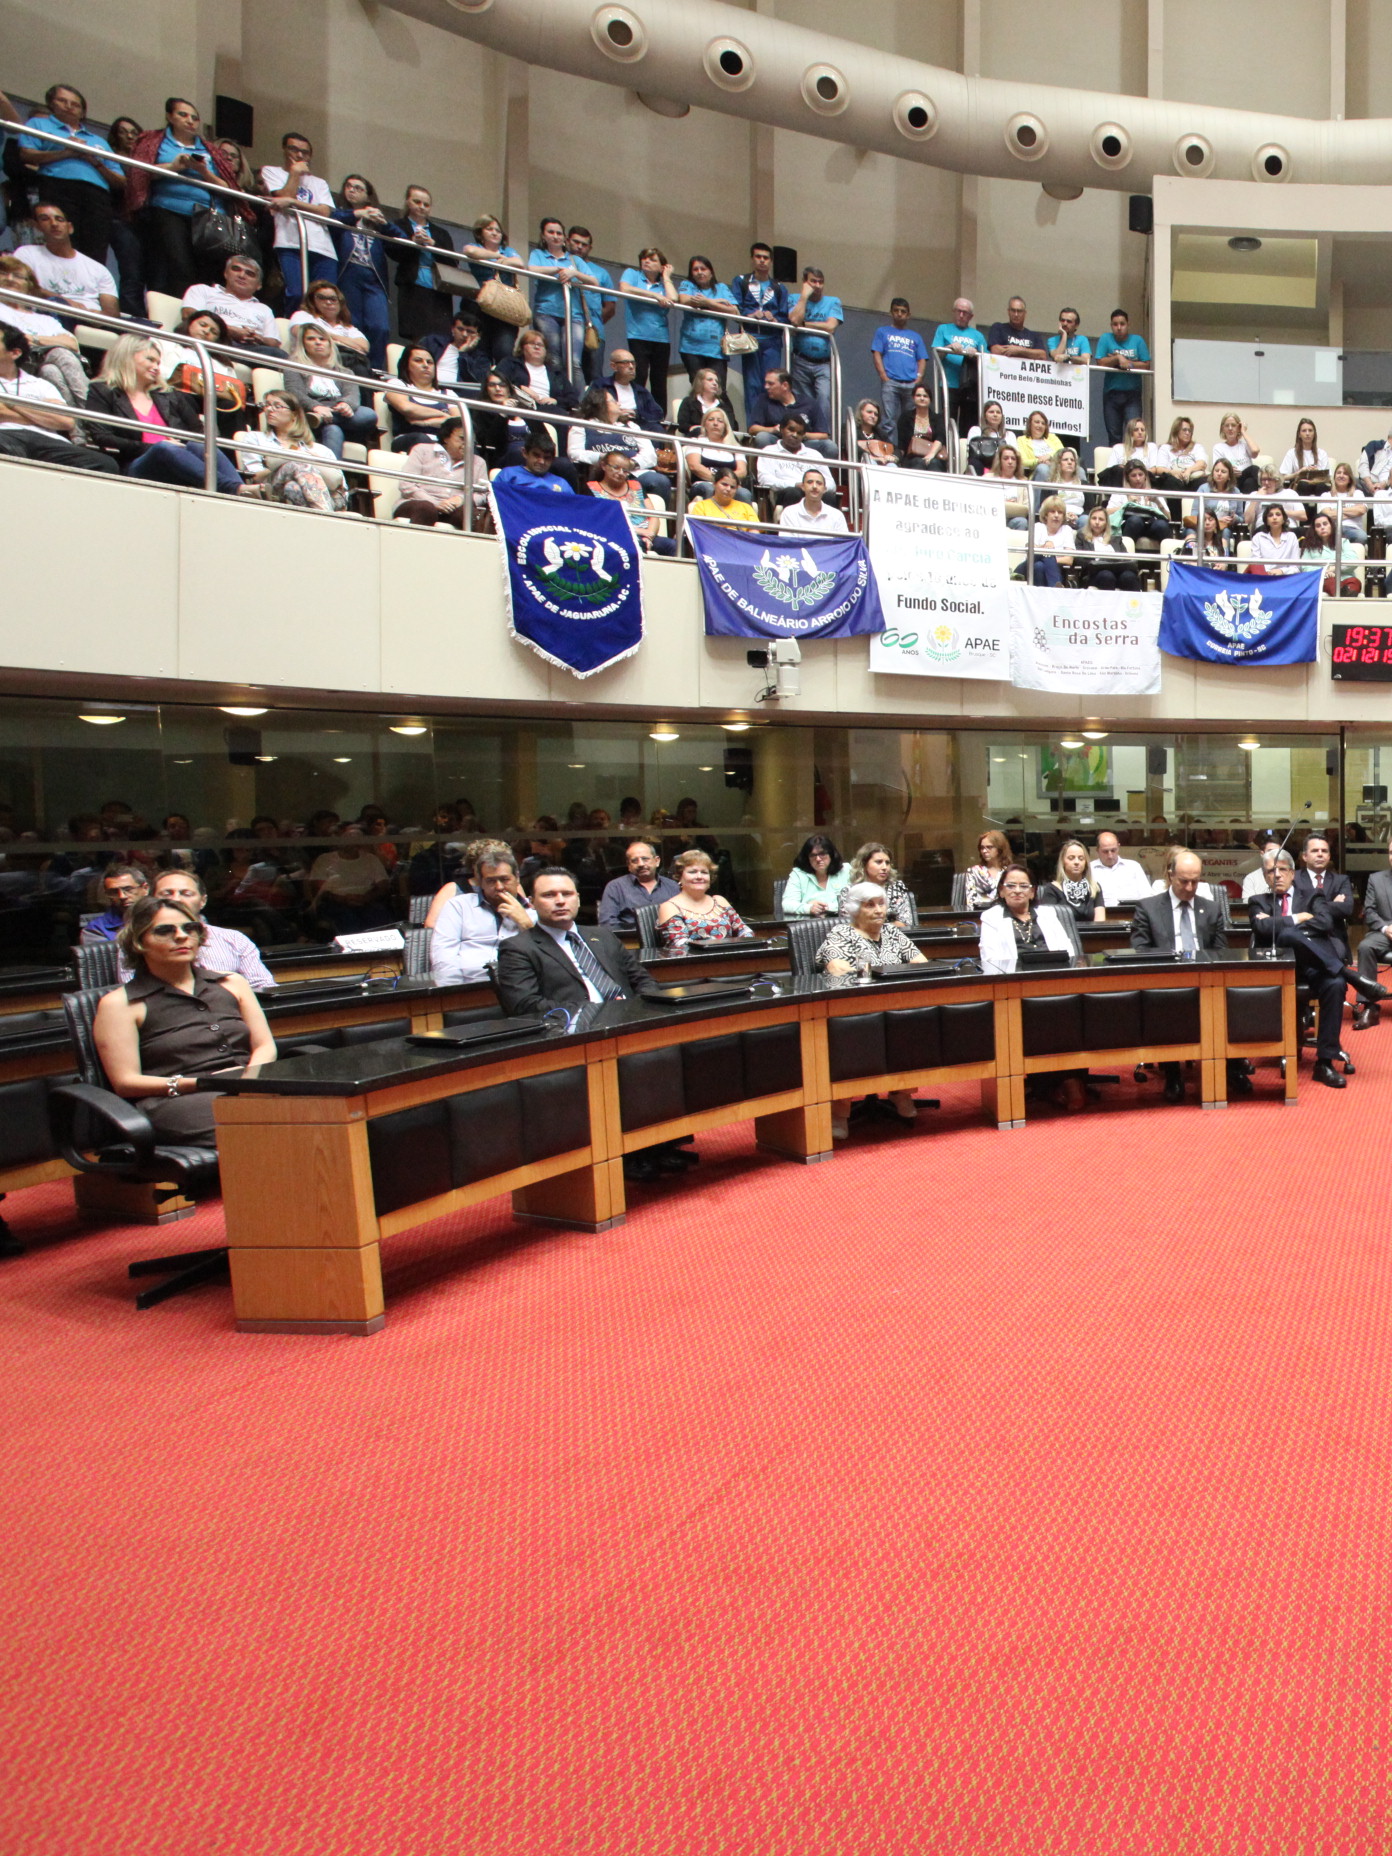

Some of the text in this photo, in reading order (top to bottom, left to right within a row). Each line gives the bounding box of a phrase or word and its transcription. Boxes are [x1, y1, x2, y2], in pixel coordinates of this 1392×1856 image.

[1020, 361, 1052, 374] A APAE
[999, 372, 1017, 381] Porto
[987, 386, 1085, 410] Presente nesse Evento.
[886, 491, 919, 508] APAE
[923, 497, 939, 510] de
[522, 579, 547, 604] APAE
[544, 601, 560, 613] DE
[702, 554, 726, 583] APAE
[720, 582, 739, 600] DE
[737, 597, 809, 629] BALNEÁRIO
[810, 601, 851, 628] ARROIO
[850, 587, 862, 604] DO
[856, 559, 869, 587] SILVA
[897, 594, 985, 615] Fundo Social.
[1052, 615, 1127, 630] Encostas
[964, 637, 1001, 651] APAE
[1068, 632, 1139, 646] da Serra
[1227, 641, 1246, 650] APAE
[344, 934, 398, 946] RESERVADO
